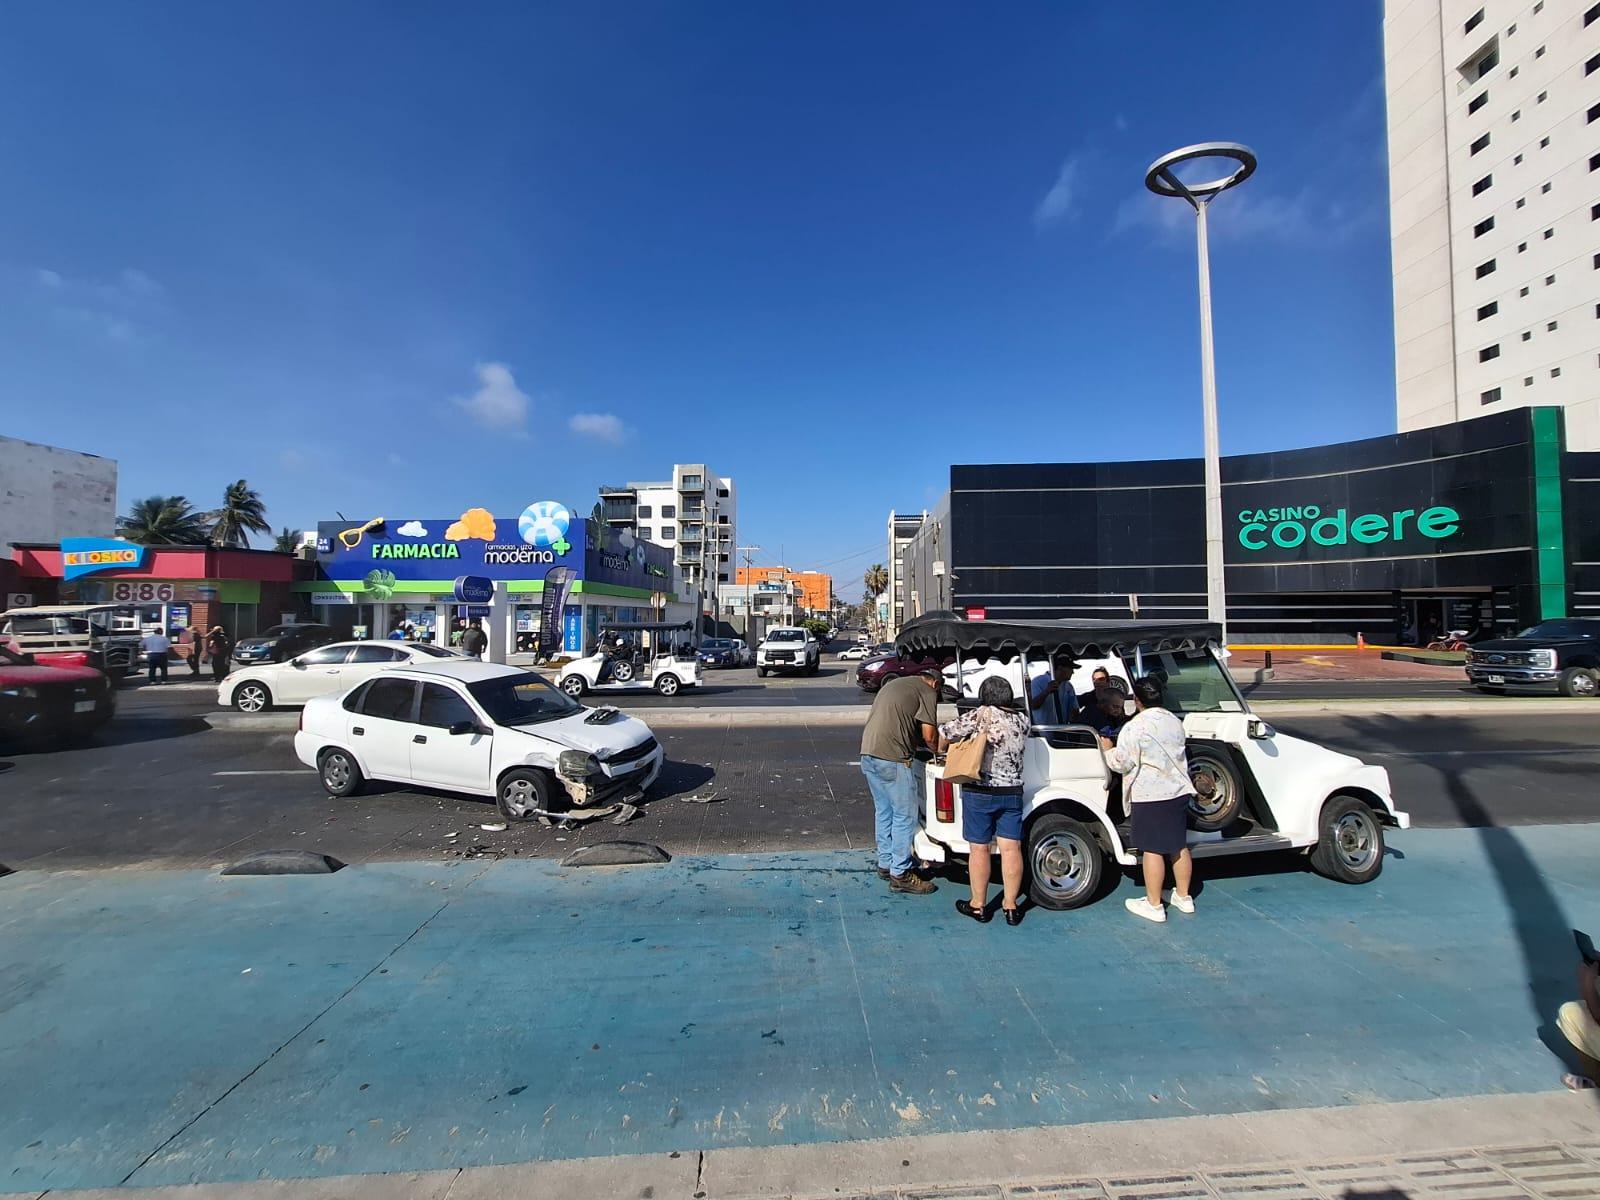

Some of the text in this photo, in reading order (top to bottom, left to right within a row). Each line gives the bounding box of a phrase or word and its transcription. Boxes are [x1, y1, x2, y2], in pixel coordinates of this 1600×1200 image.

[1238, 505, 1321, 523] CASINO
[1238, 506, 1460, 550] codere
[66, 551, 135, 564] KIOSKO
[372, 543, 459, 558] FARMACIA
[484, 548, 554, 563] moderna
